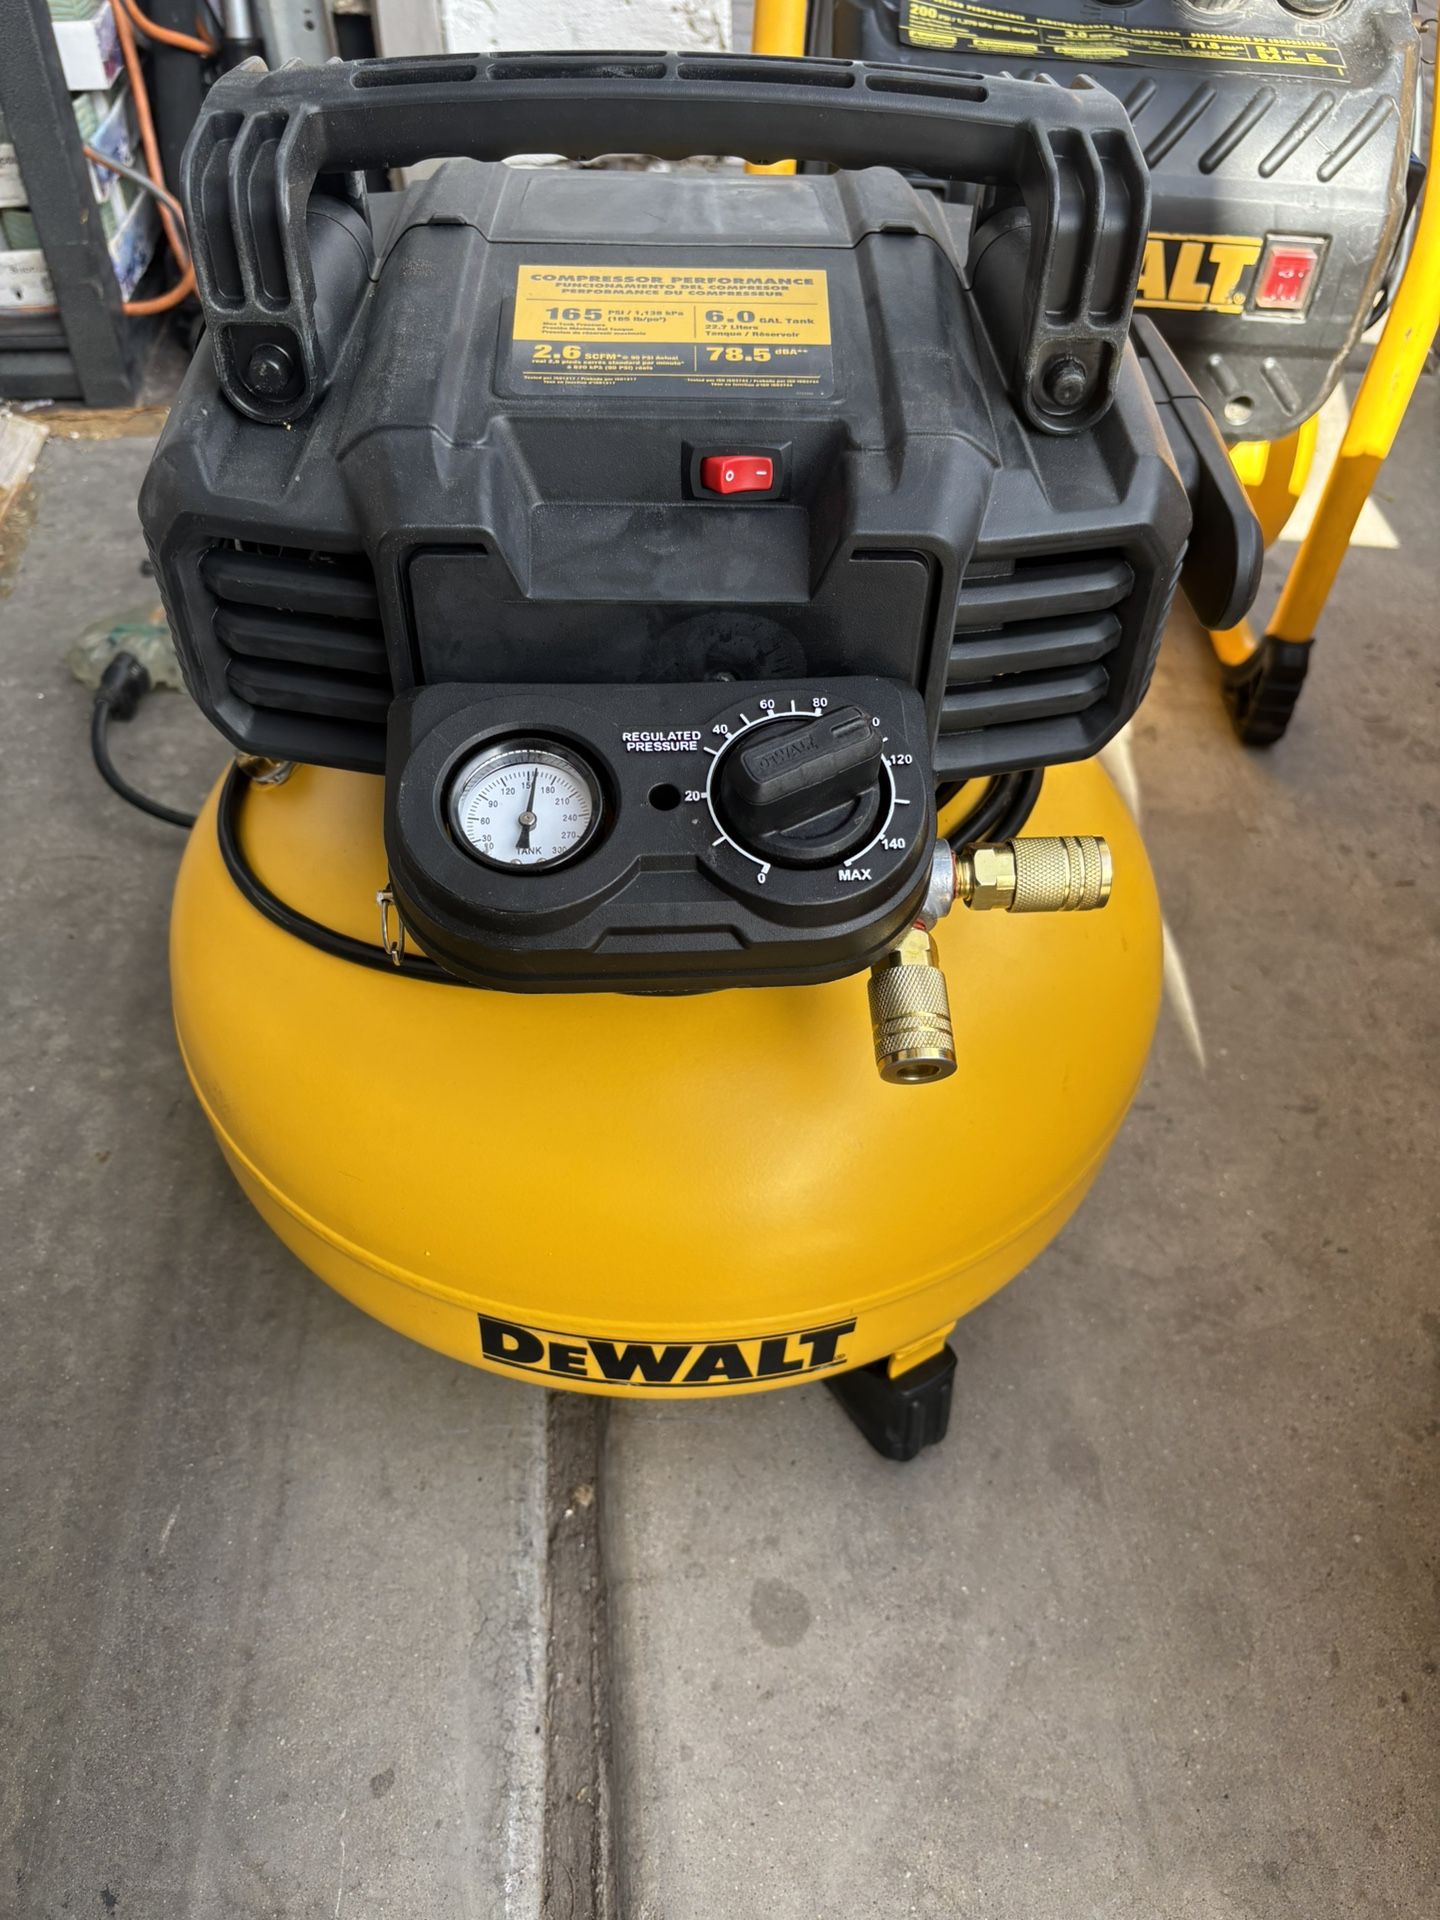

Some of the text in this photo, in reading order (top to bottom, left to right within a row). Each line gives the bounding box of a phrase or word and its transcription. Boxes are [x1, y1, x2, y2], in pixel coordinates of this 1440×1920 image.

[531, 274, 814, 286] COMPRESSOR PERFORMANCE
[555, 282, 675, 290] FUNCIONAMIENTO
[545, 307, 602, 321] 165
[705, 310, 755, 323] 6.0
[533, 344, 582, 360] 2.6
[706, 347, 771, 362] 78.5
[759, 699, 775, 709] 60
[812, 698, 828, 707] 80
[712, 724, 728, 734] 40
[622, 731, 701, 742] REGULATED
[627, 741, 698, 752] PRESSURE
[890, 754, 913, 765] 120
[541, 786, 555, 794] 180
[684, 790, 701, 801] 20
[488, 800, 498, 808] 90
[480, 817, 490, 825] 60
[482, 834, 491, 842] 30
[881, 838, 906, 850] 140
[757, 873, 766, 883] 0
[838, 869, 873, 881] MAX
